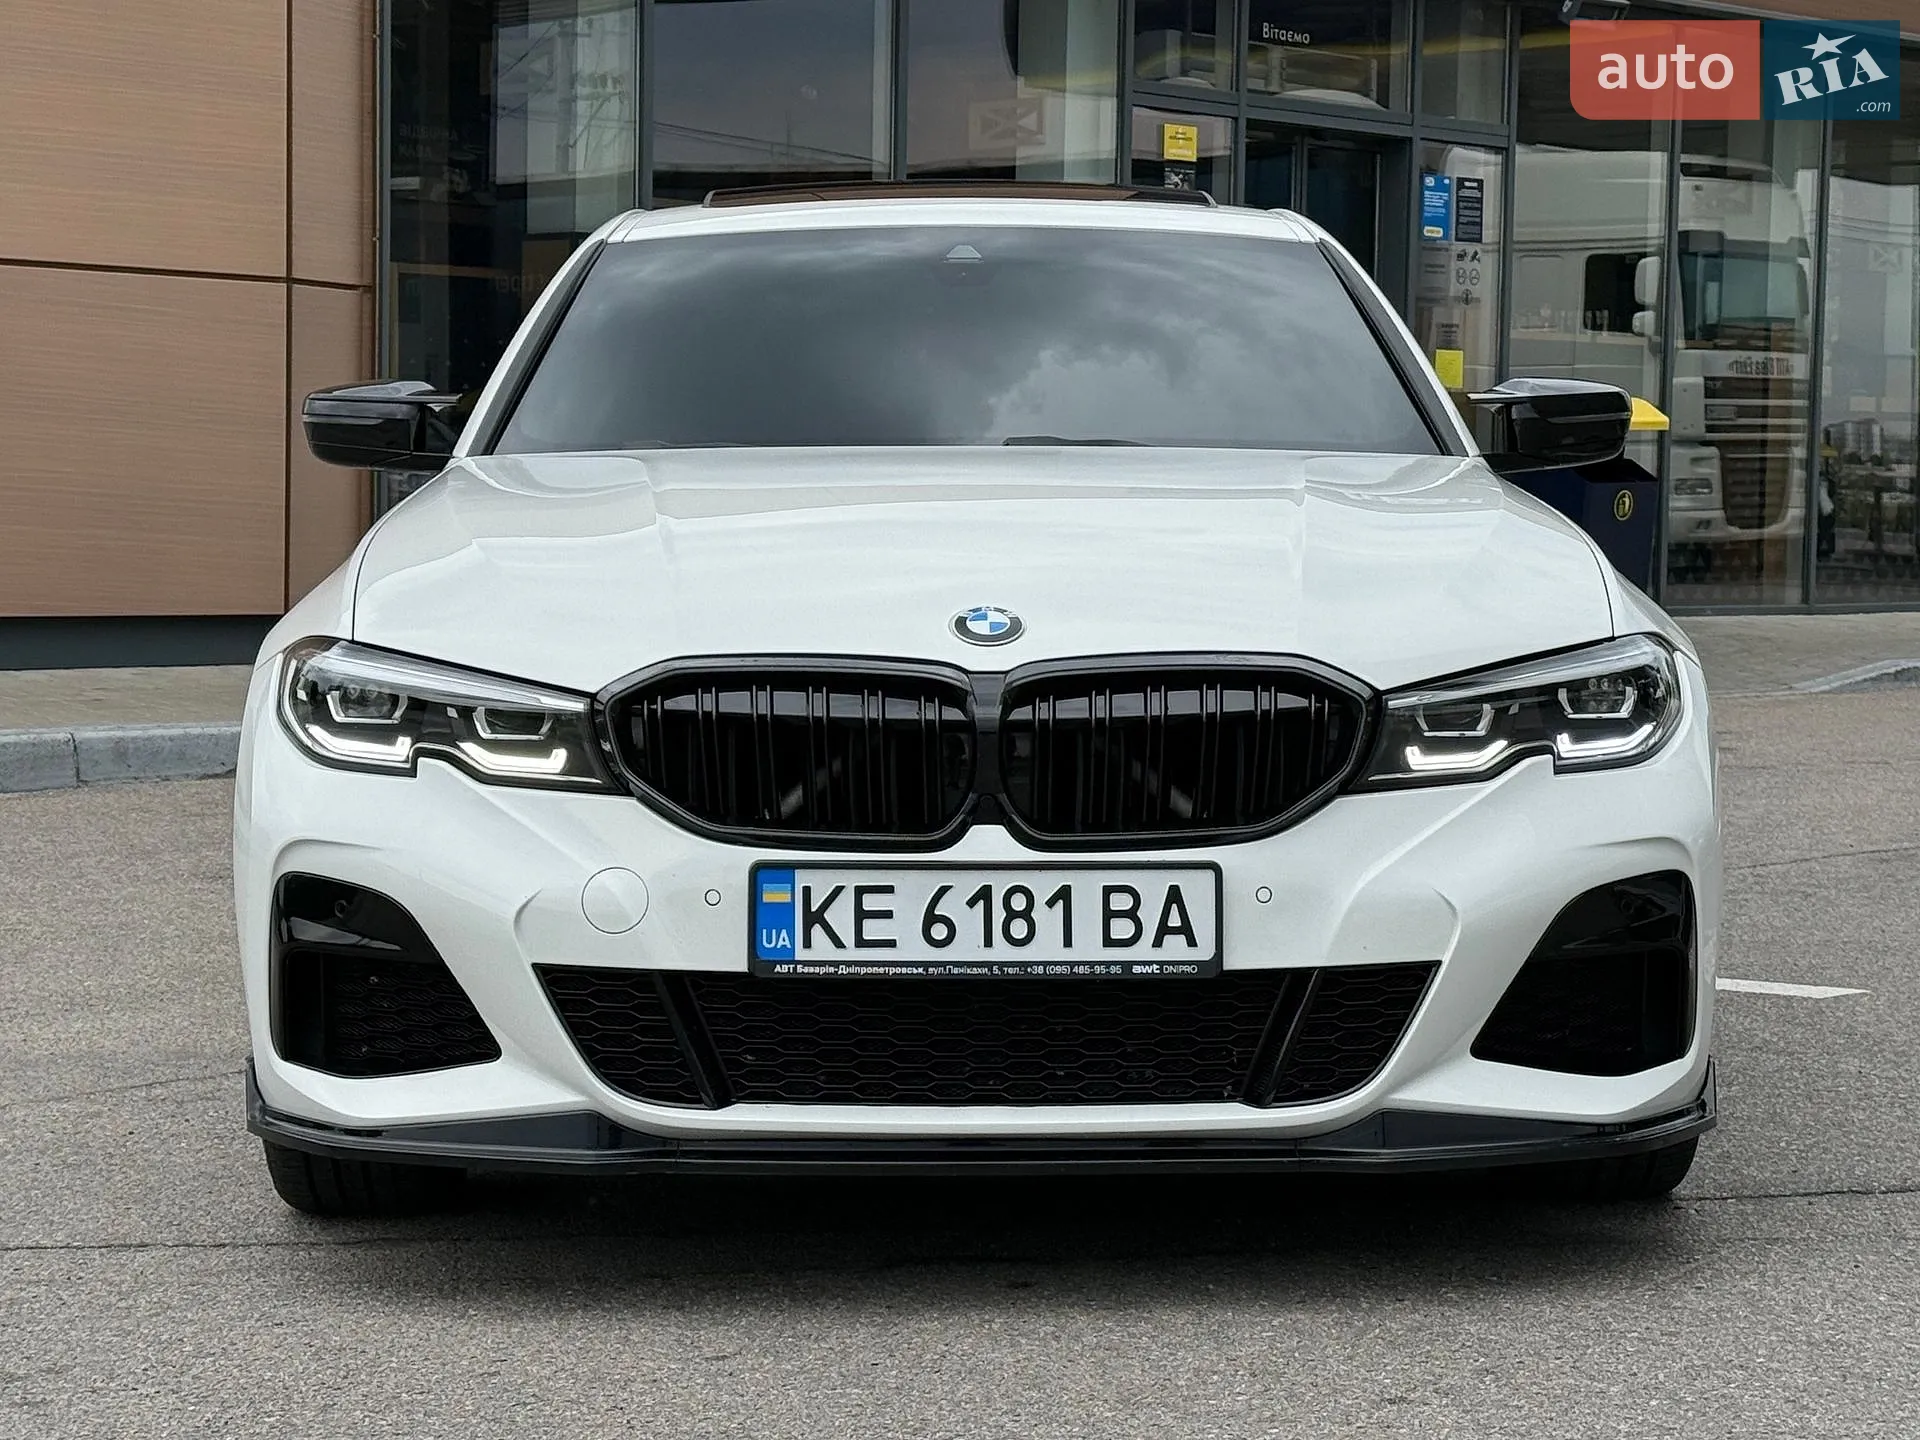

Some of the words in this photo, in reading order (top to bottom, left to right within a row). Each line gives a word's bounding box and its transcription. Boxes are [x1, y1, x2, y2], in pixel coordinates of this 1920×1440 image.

[1262, 22, 1310, 44] Вітаємо
[802, 885, 897, 949] KE
[921, 884, 1072, 949] 6181
[1103, 884, 1198, 949] BA
[762, 929, 792, 949] UA
[1046, 964, 1071, 976] (095)
[1072, 965, 1123, 975] 485-95-95
[1163, 964, 1198, 974] DNIPRO
